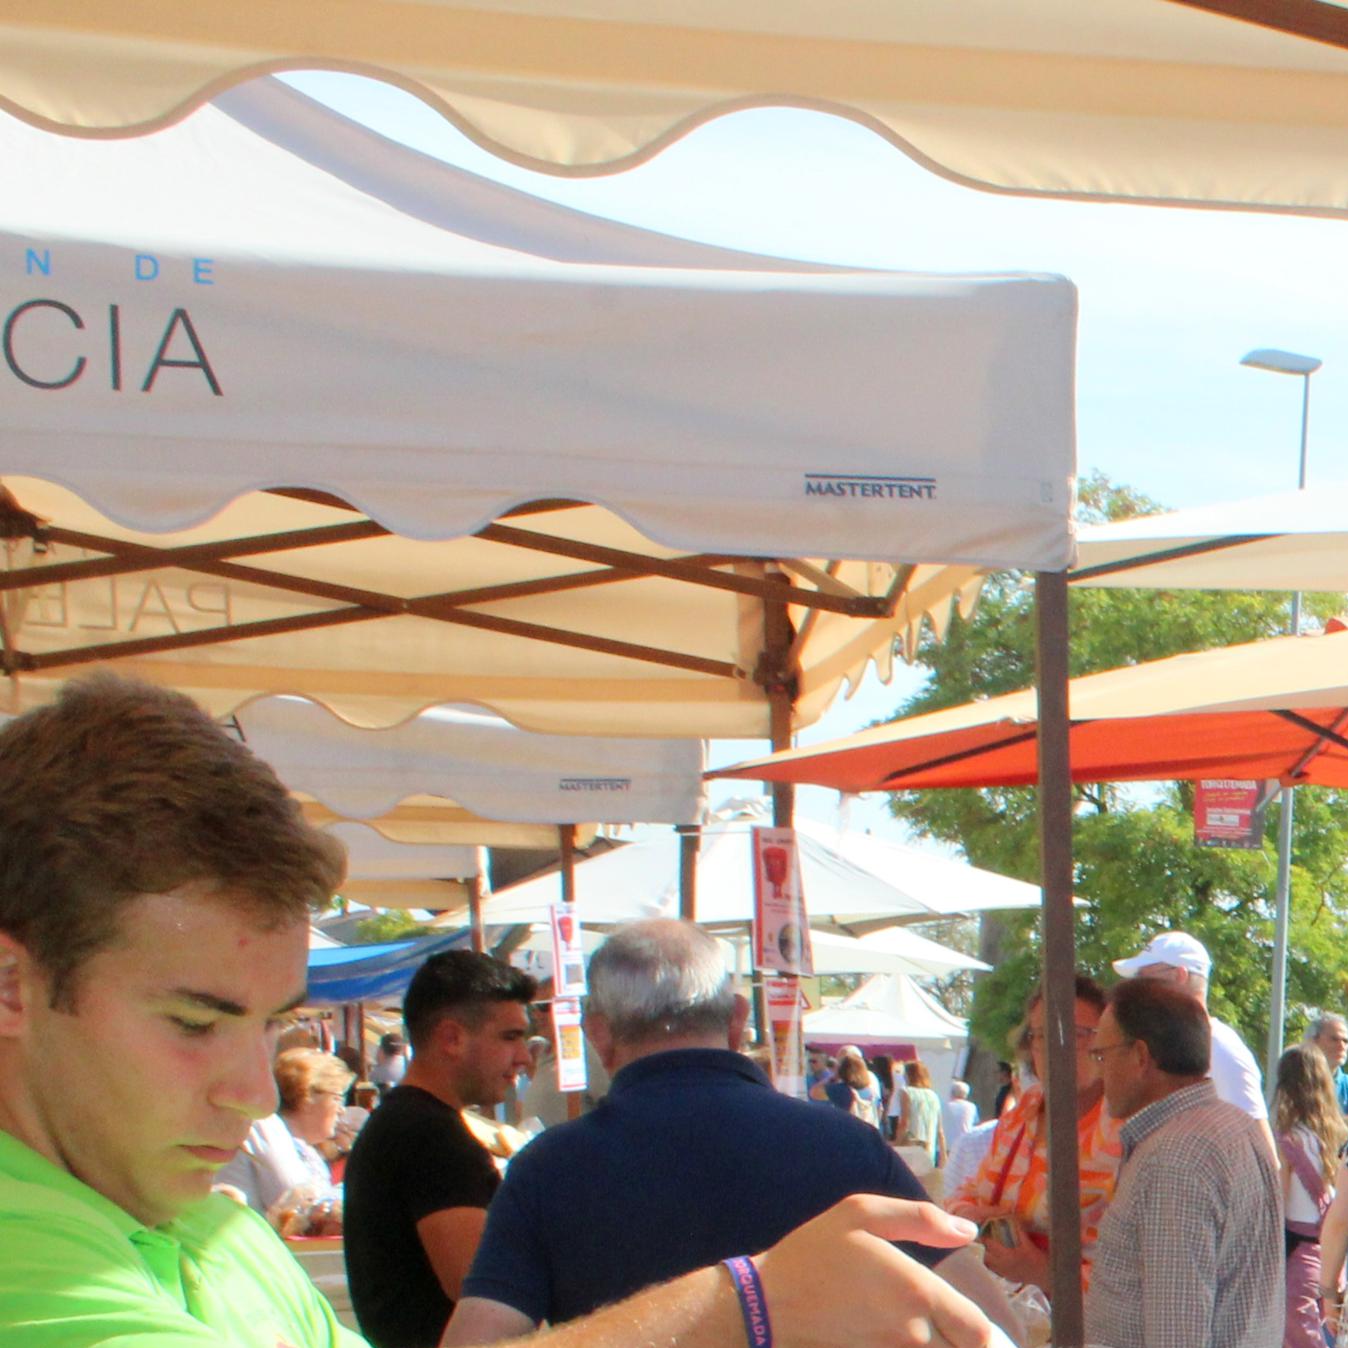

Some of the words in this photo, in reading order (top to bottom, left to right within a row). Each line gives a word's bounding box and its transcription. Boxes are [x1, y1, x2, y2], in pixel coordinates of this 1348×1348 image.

[135, 254, 215, 285] DE
[3, 299, 223, 397] CIA
[804, 480, 936, 499] MASTERTENT
